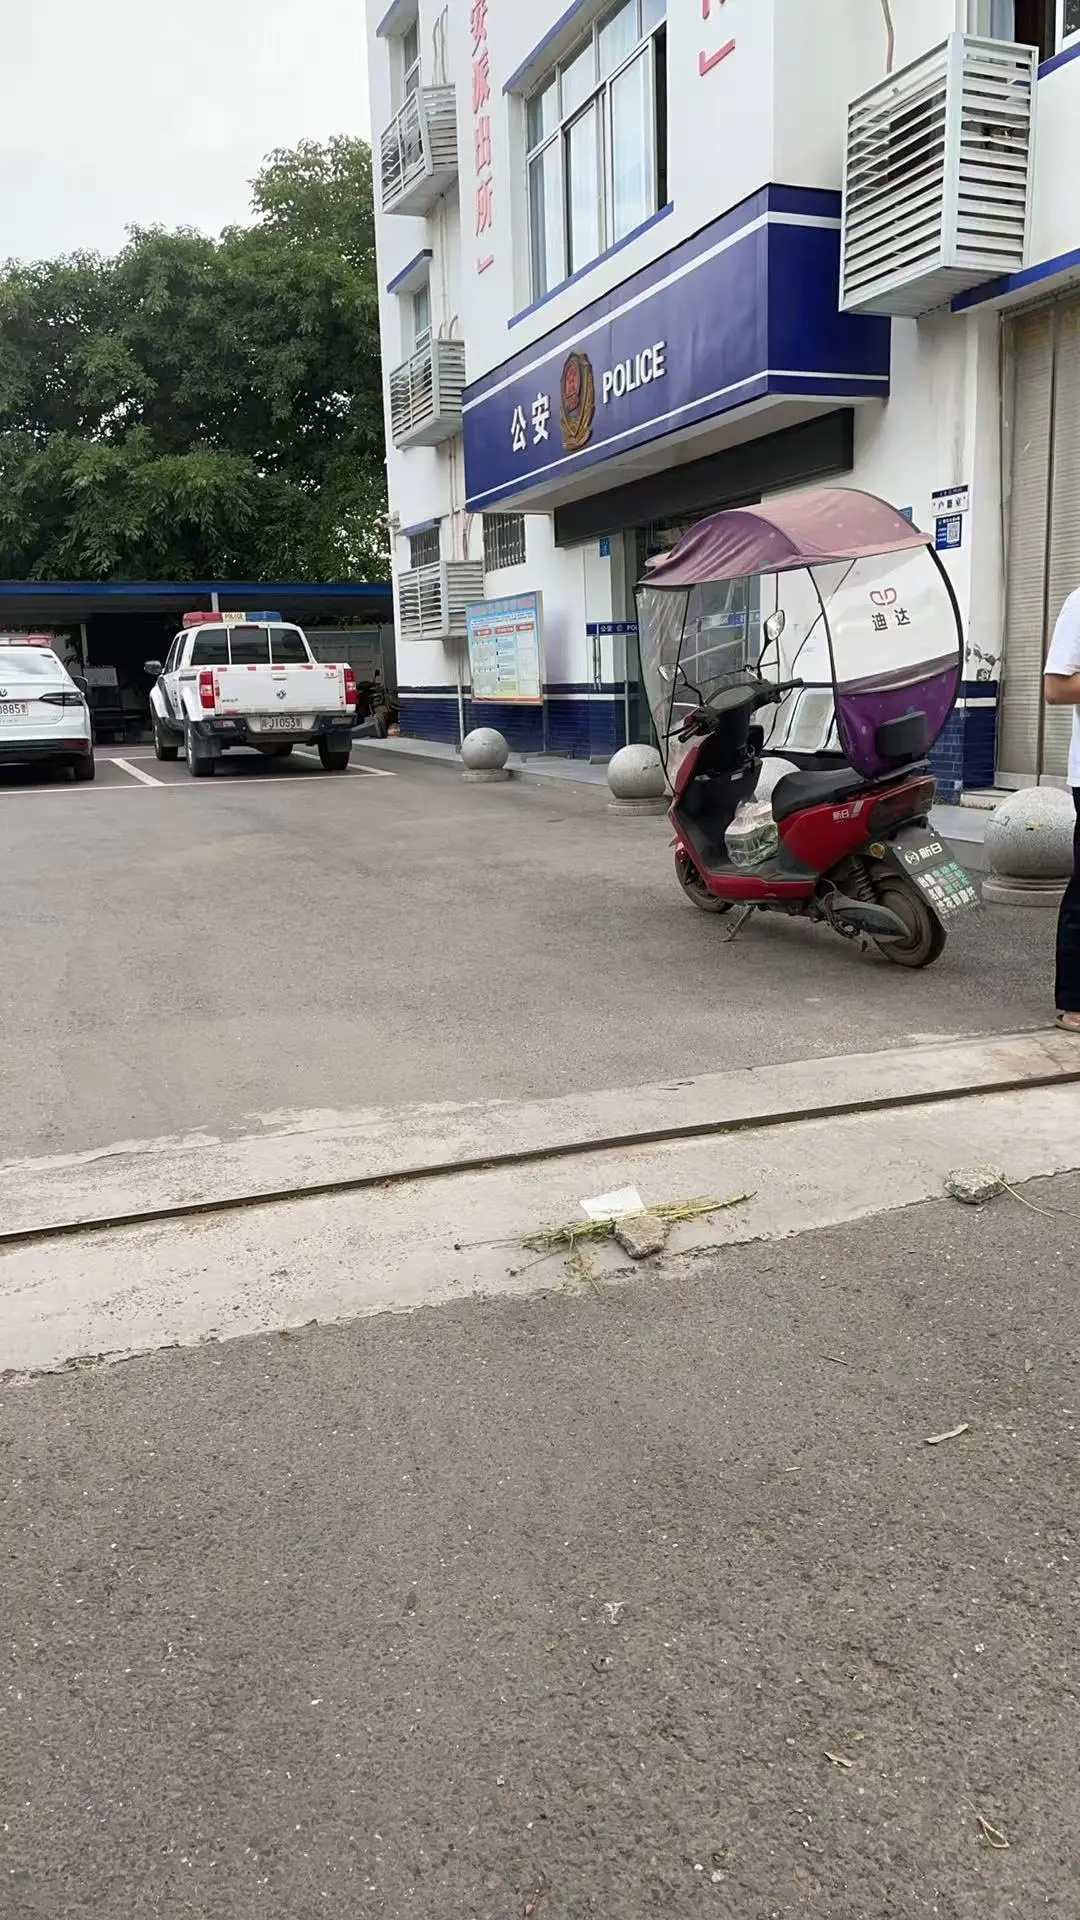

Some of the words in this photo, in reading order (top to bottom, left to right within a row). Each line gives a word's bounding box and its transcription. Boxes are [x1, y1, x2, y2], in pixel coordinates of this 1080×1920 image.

[511, 392, 550, 452] 公安
[602, 341, 666, 404] POLICE
[871, 607, 911, 631] 迪达
[918, 842, 943, 859] 新日
